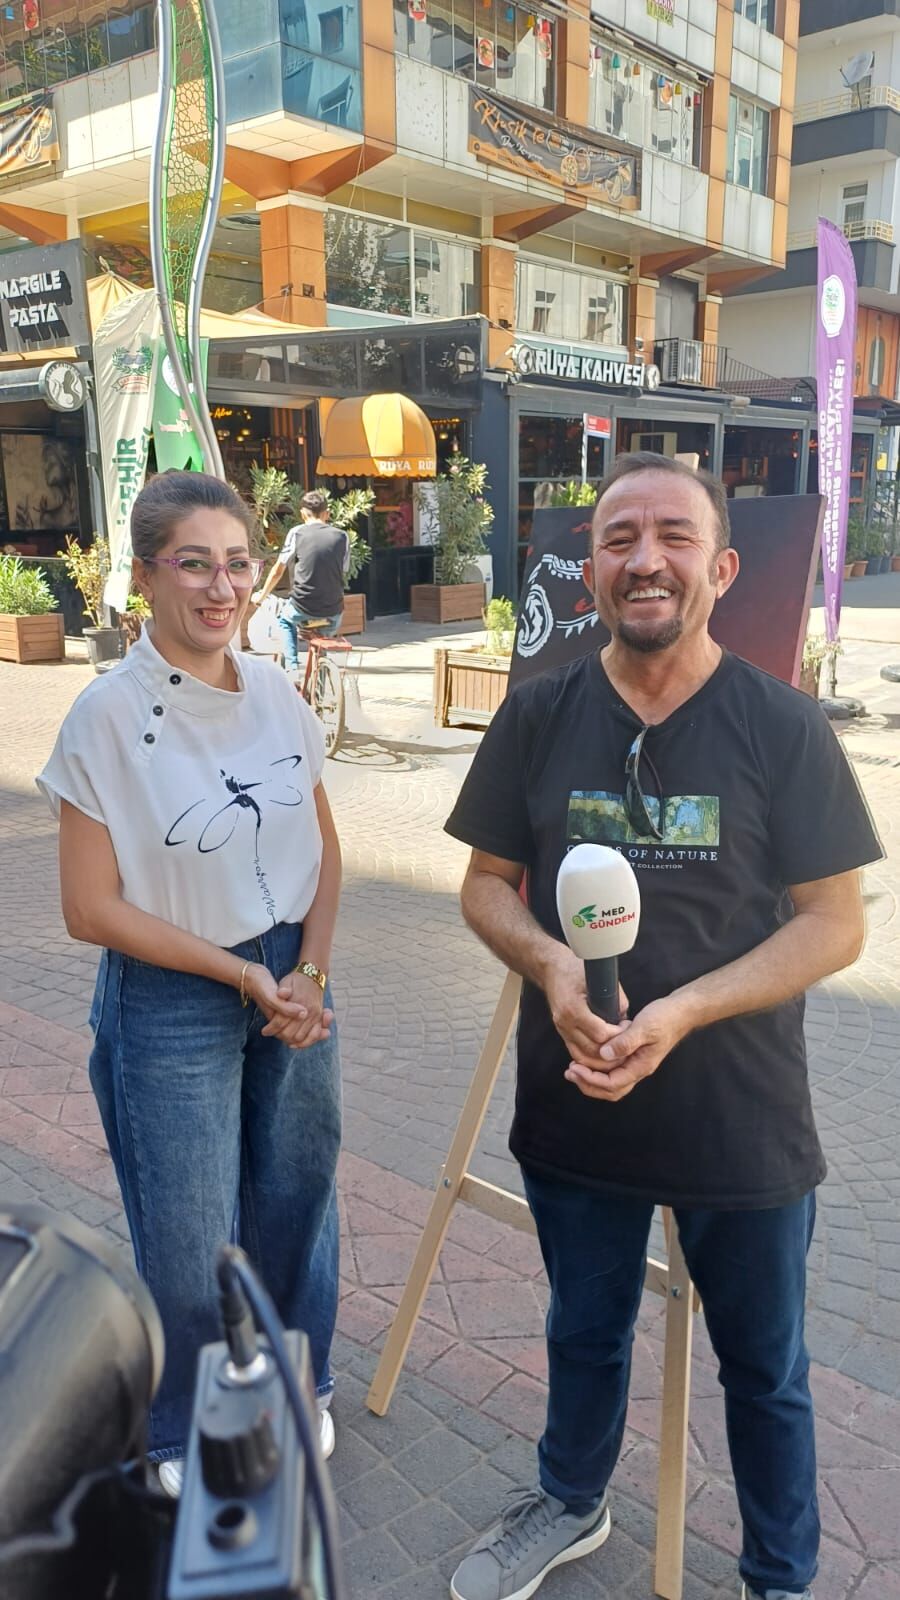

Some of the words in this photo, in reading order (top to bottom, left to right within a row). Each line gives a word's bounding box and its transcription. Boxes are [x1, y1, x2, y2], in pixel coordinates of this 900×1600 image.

[9, 302, 59, 328] PASTA
[379, 458, 412, 470] RÜYA
[628, 848, 648, 859] OF
[655, 850, 718, 861] NATURE
[601, 906, 625, 918] MED
[590, 911, 635, 930] GÜNDEM
